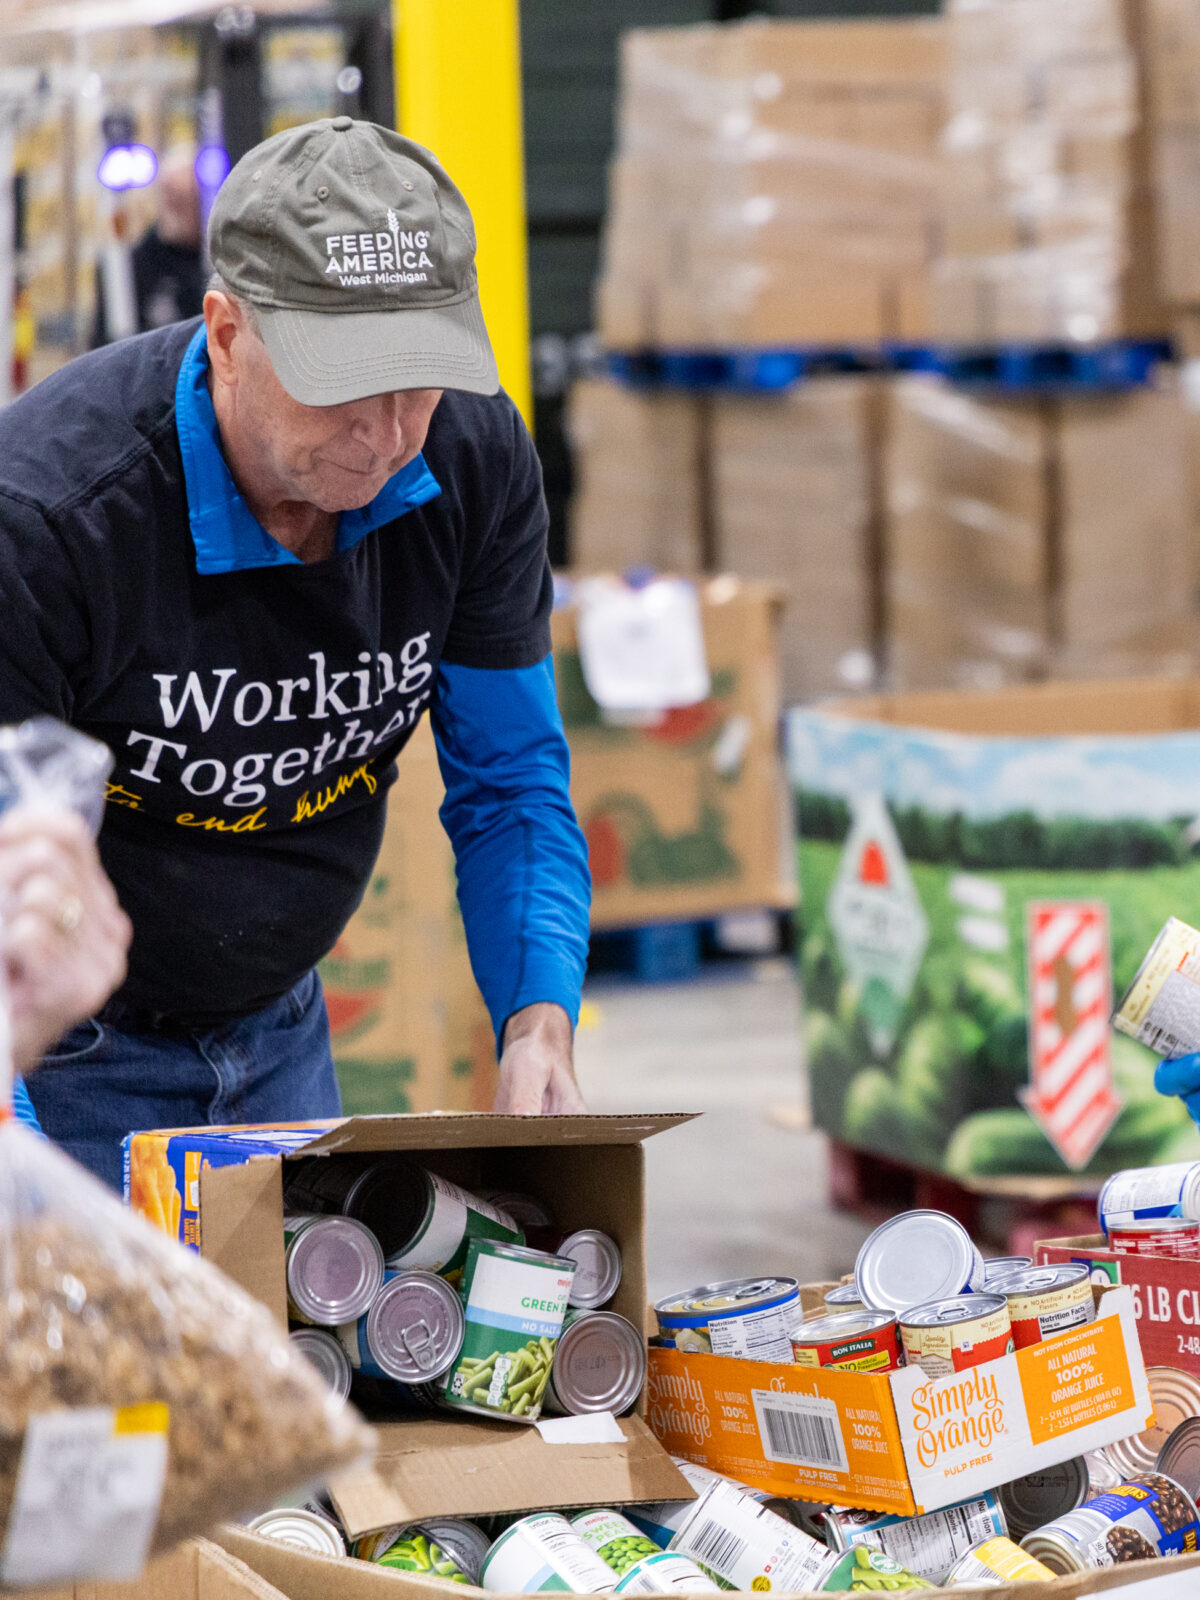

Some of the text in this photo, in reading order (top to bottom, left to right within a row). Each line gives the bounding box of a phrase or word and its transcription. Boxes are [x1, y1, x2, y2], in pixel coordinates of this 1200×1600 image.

[325, 230, 429, 255] FEEDING
[325, 250, 435, 273] AMERICA
[338, 271, 428, 287] West Michigan
[152, 630, 433, 733] Working
[126, 689, 431, 807] Together
[175, 805, 269, 833] end
[520, 1296, 560, 1313] GREEN
[1039, 1306, 1086, 1324] Nutrition Facts
[1146, 1285, 1172, 1322] LB
[521, 1321, 537, 1332] NO
[832, 1341, 873, 1357] BON ITALIA
[1033, 1348, 1046, 1357] NOT
[1046, 1342, 1063, 1353] FROM
[1047, 1343, 1098, 1371] ALL NATURAL
[1177, 1335, 1200, 1355] 2-48
[1055, 1360, 1095, 1384] 100%
[647, 1360, 710, 1414] Simply
[911, 1367, 1004, 1431] Simply
[1051, 1372, 1105, 1404] ORANGE JUICE
[650, 1402, 713, 1446] Orange
[720, 1405, 749, 1420] 100%
[845, 1407, 883, 1423] ALL NATURAL
[852, 1423, 881, 1438] 100%
[916, 1407, 1005, 1468] Orange
[851, 1438, 873, 1452] ORANGE
[798, 1468, 838, 1482] PULP FREE
[943, 1453, 993, 1478] PULP FREE
[946, 1509, 958, 1536] Calories
